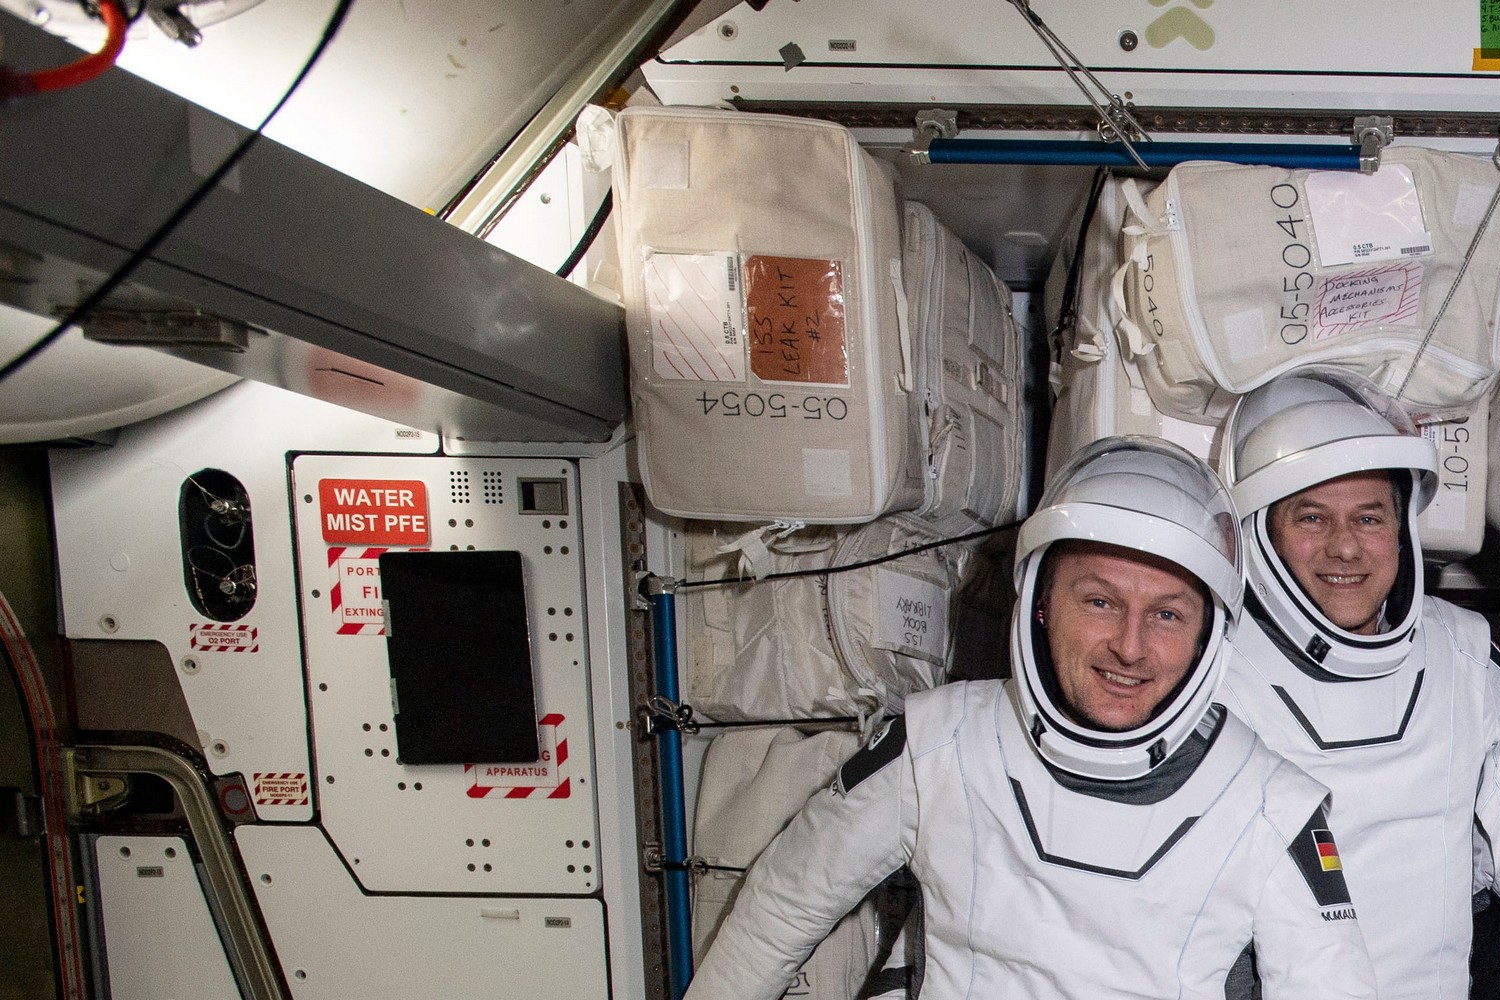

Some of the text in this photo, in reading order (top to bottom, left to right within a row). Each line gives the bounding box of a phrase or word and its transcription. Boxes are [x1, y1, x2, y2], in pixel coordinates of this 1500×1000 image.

[1270, 184, 1314, 345] 0.5-5040
[1325, 276, 1379, 292] DOCKING
[1330, 284, 1404, 303] MECHANISMS
[1143, 254, 1163, 336] 5040
[777, 266, 800, 375] LEAK KIT
[806, 308, 821, 343] #2
[1349, 310, 1371, 322] KIT
[696, 391, 848, 421] 0.5-5054
[1444, 416, 1470, 492] 1.0-5
[334, 488, 414, 507] WATER
[327, 513, 426, 533] MIST PFE
[895, 596, 932, 618] LIBRARY
[902, 615, 927, 632] BOOK
[486, 768, 548, 776] APPARATUS
